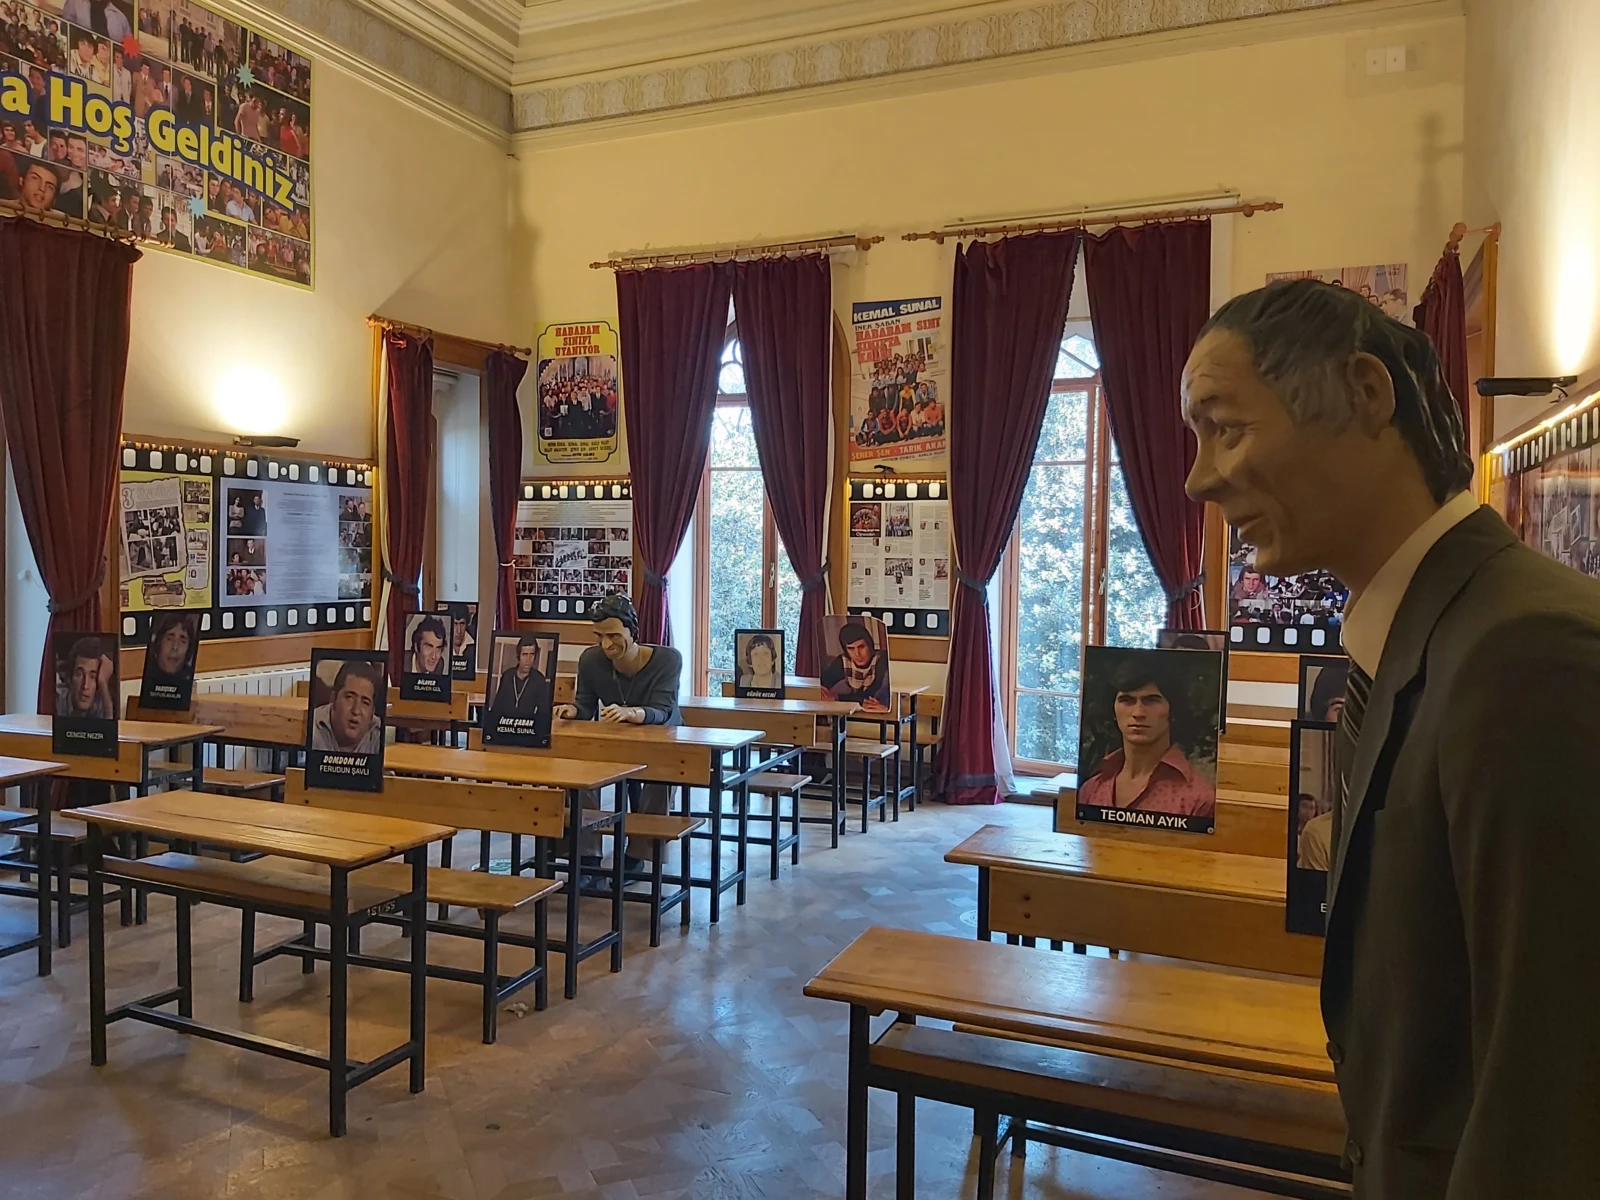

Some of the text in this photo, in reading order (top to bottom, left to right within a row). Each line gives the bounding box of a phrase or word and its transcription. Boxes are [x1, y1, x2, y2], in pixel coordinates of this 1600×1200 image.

[50, 77, 133, 151] Hoş
[148, 109, 296, 211] Geldiniz
[853, 299, 940, 322] KEMAL SUNAL
[555, 325, 600, 337] HABABAM
[856, 322, 912, 341] HABABAM
[563, 336, 592, 346] SINIFI
[555, 345, 600, 356] UYANIYOR
[191, 447, 218, 456] FILM
[899, 444, 922, 454] TARIK
[497, 726, 536, 735] KEMAL SUNAL
[323, 755, 368, 767] DOMDOM ALİ
[319, 764, 370, 776] FERUDUN ŞAVLI
[1100, 809, 1188, 829] TEOMAN AYIK
